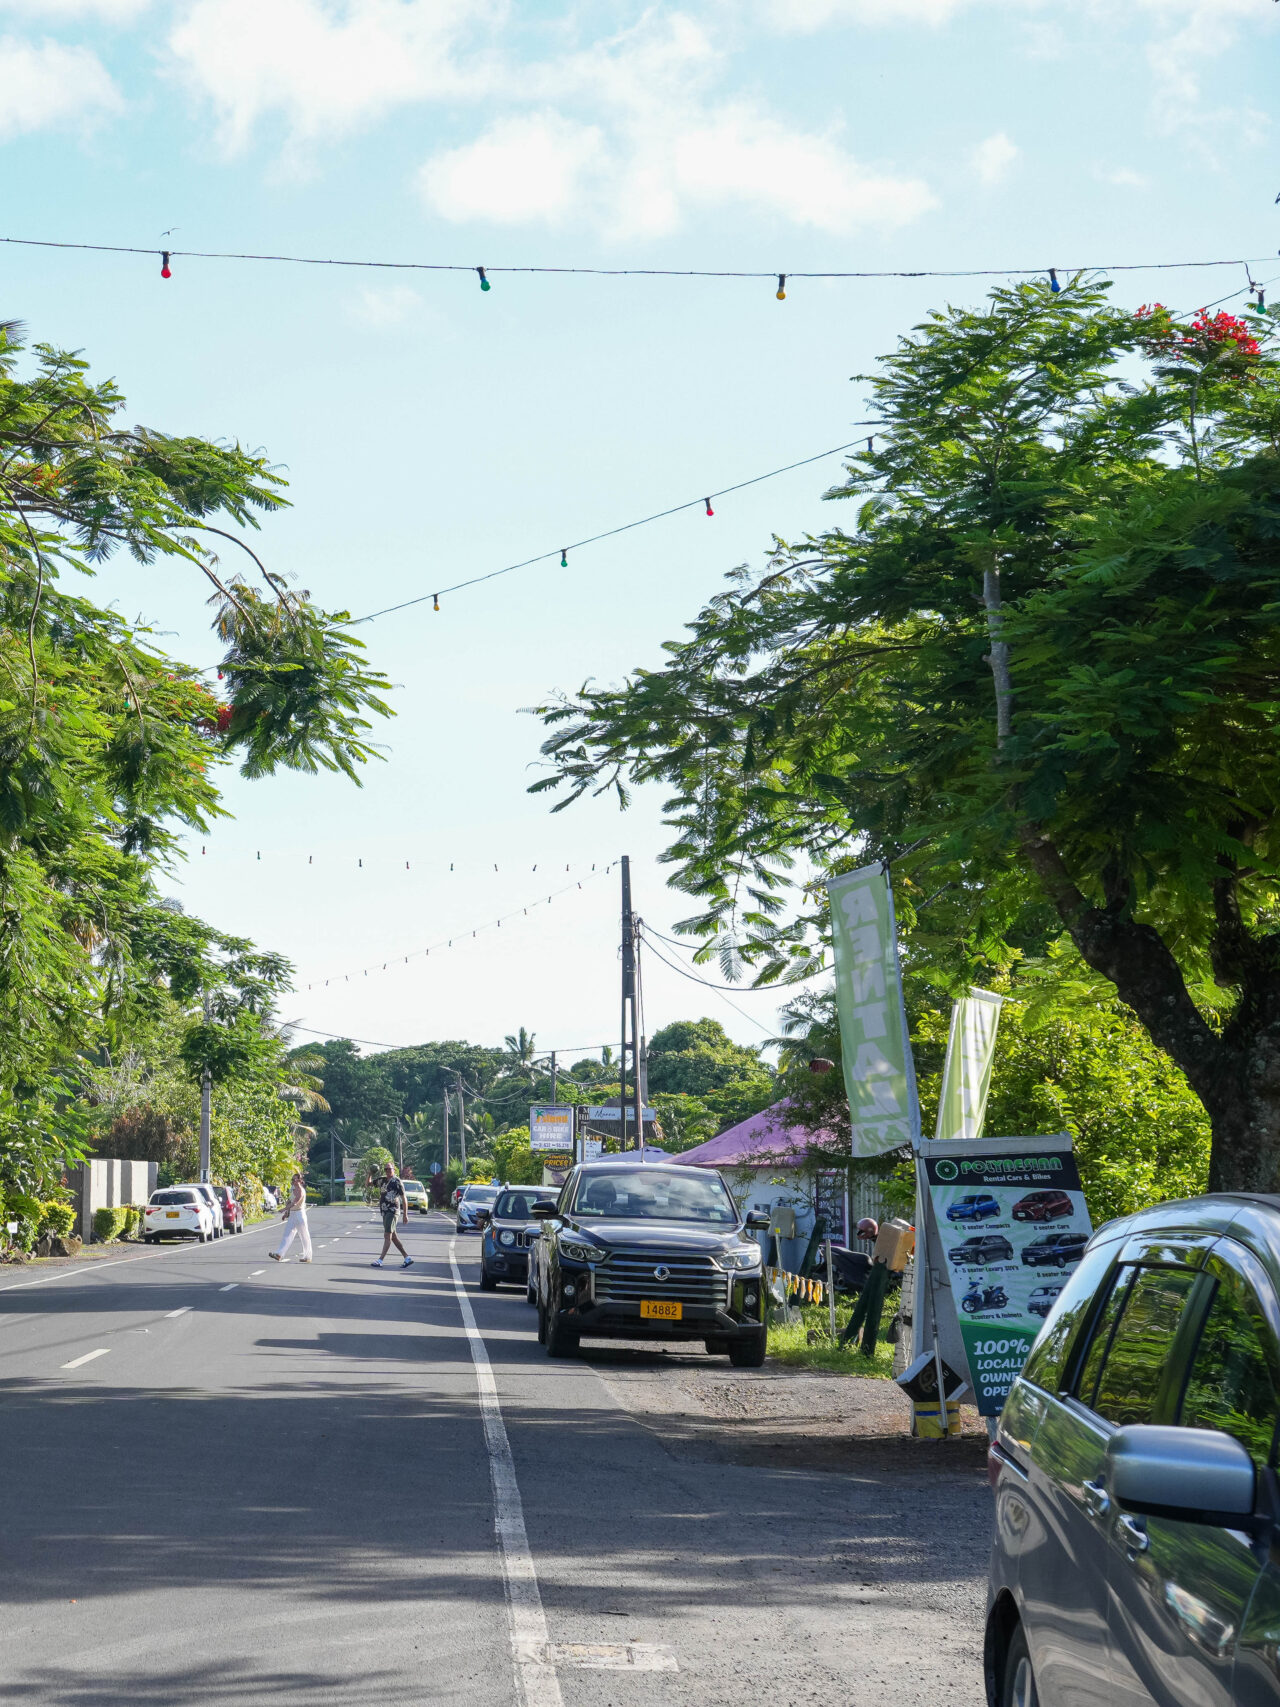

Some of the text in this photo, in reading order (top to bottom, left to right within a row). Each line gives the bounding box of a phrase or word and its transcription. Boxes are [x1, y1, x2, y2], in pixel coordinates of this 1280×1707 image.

[961, 1157, 1063, 1174] POLYNESIAN
[647, 1305, 677, 1315] 14882
[973, 1338, 1030, 1356] 100%
[980, 1371, 1019, 1383] OWNE
